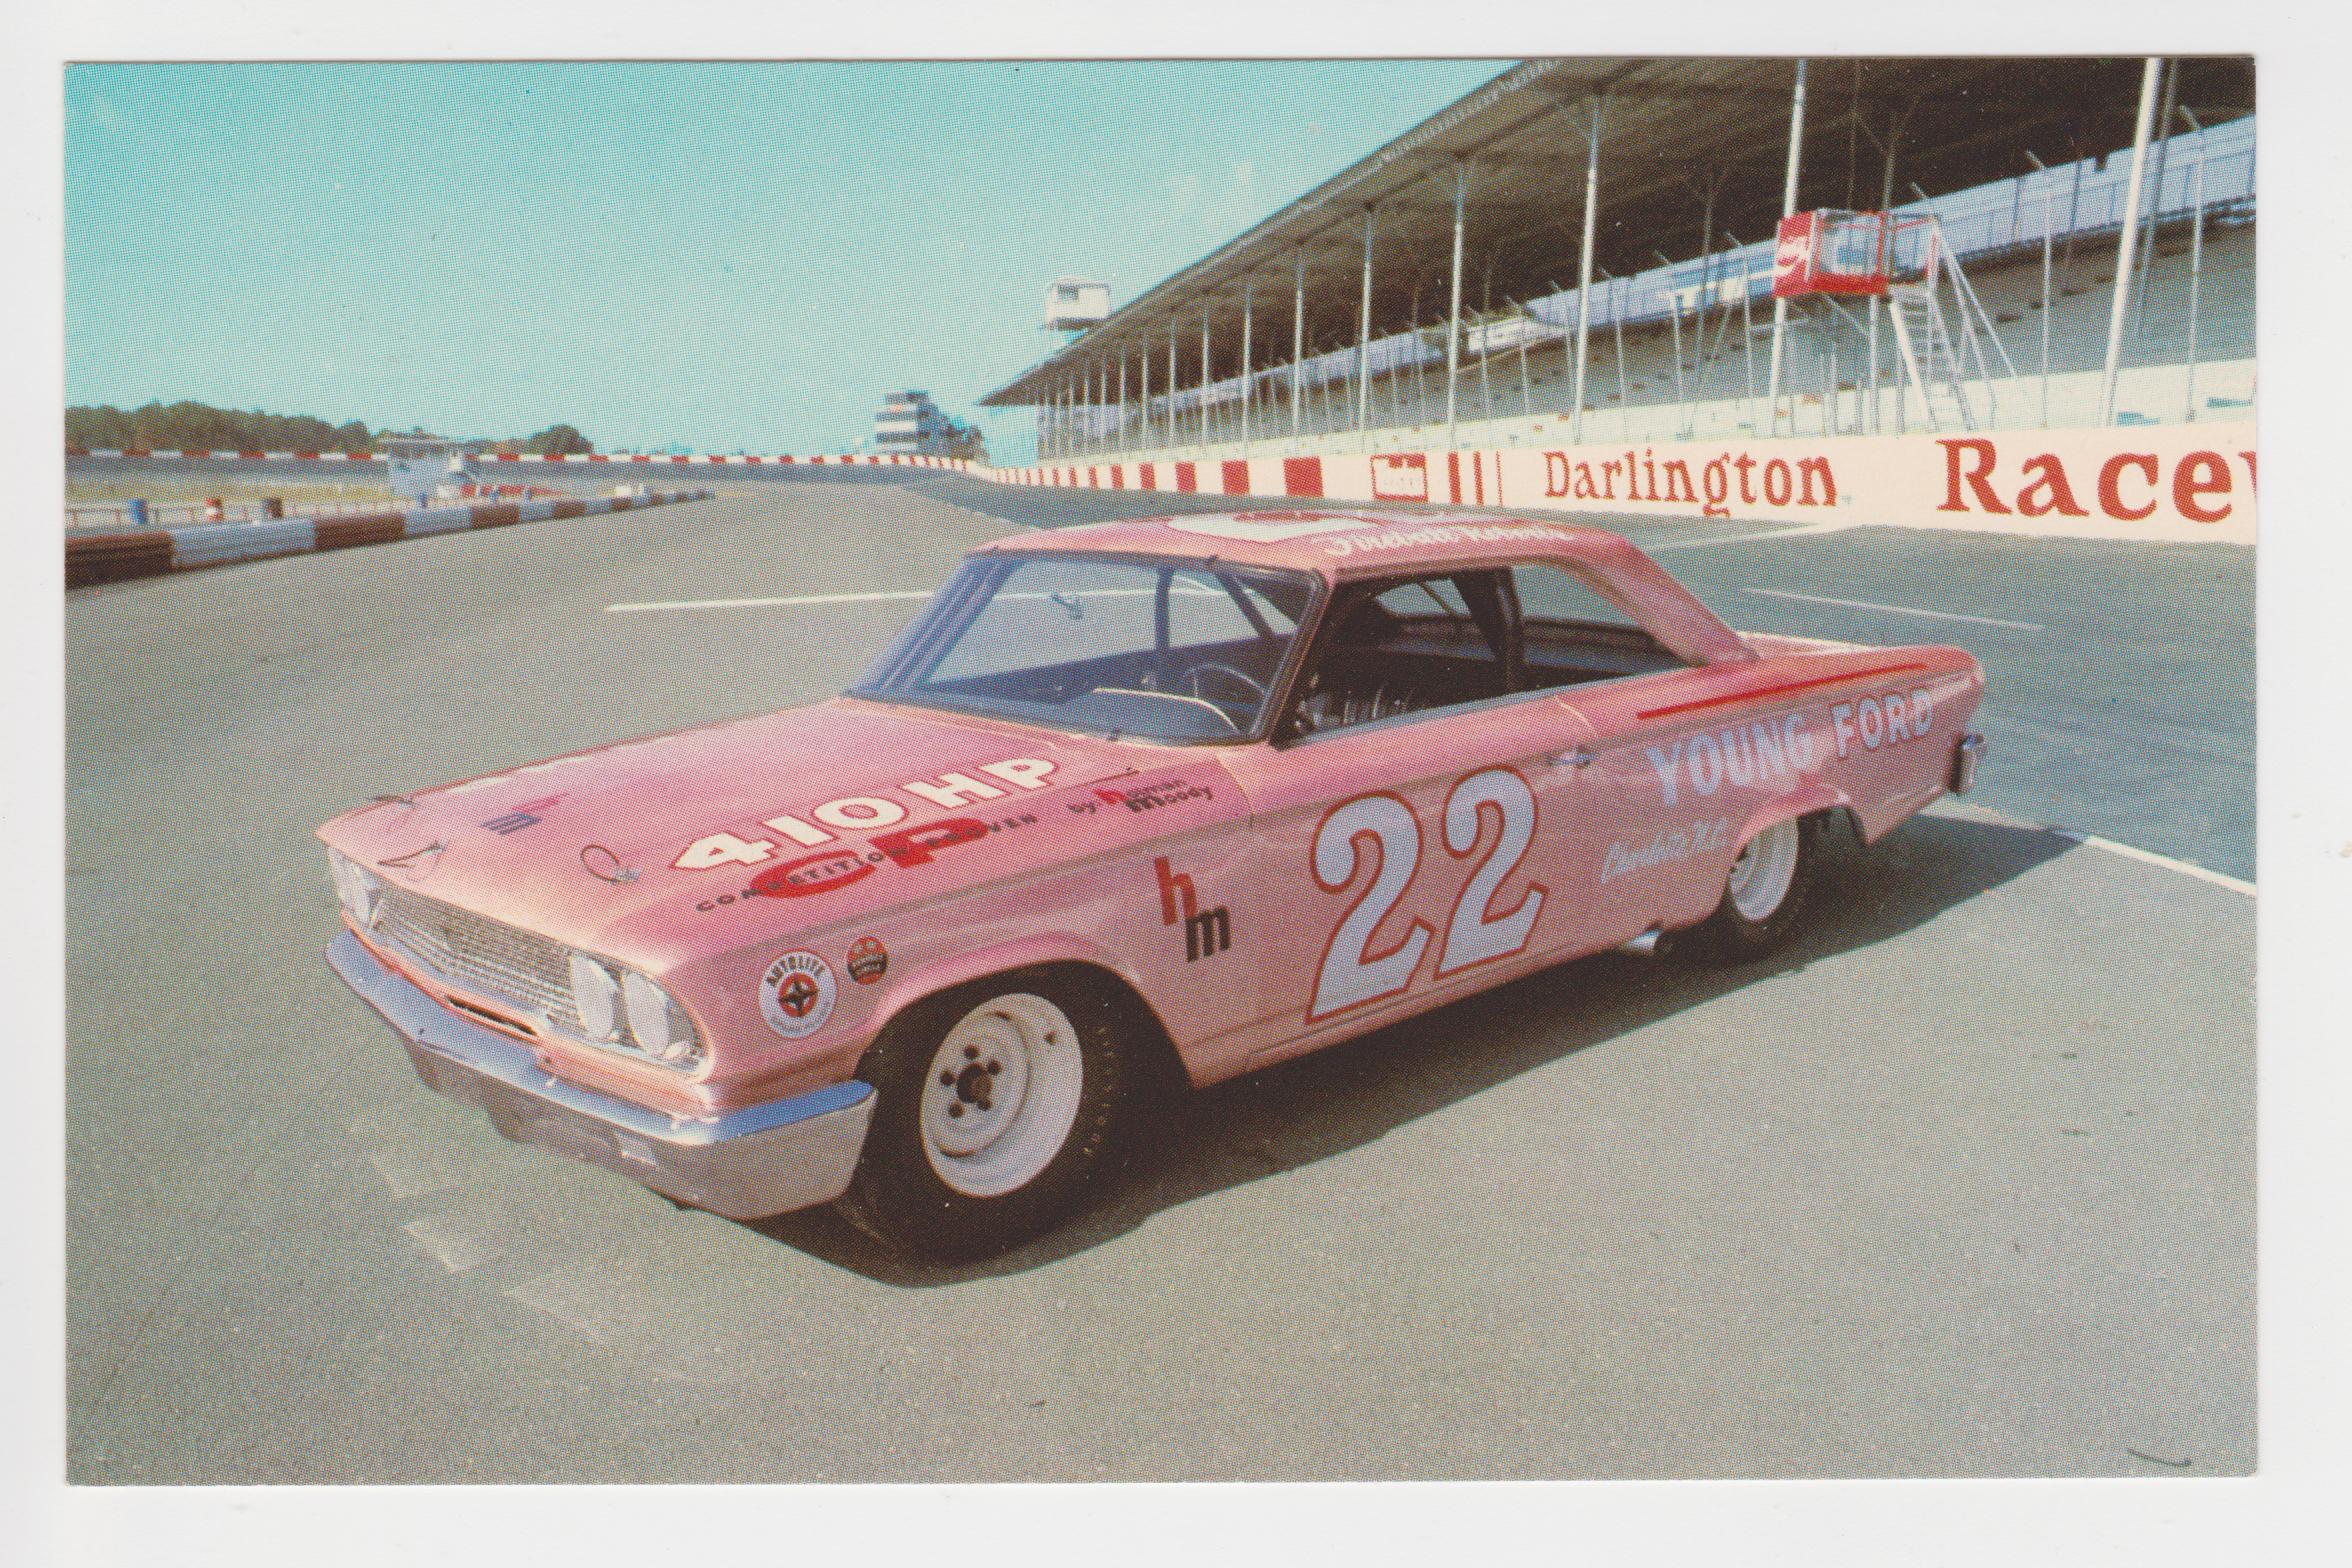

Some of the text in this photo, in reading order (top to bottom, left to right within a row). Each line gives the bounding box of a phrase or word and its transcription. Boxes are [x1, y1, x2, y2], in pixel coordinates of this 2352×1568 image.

[1542, 438, 2256, 524] Darlington Race
[1646, 688, 1935, 806] YOUNG FORD
[669, 755, 1061, 872] 410 HP
[1067, 801, 1097, 814] by
[695, 848, 909, 914] COMPETITION
[1304, 764, 1550, 1025] 22
[766, 955, 826, 987] AUTOLITE
